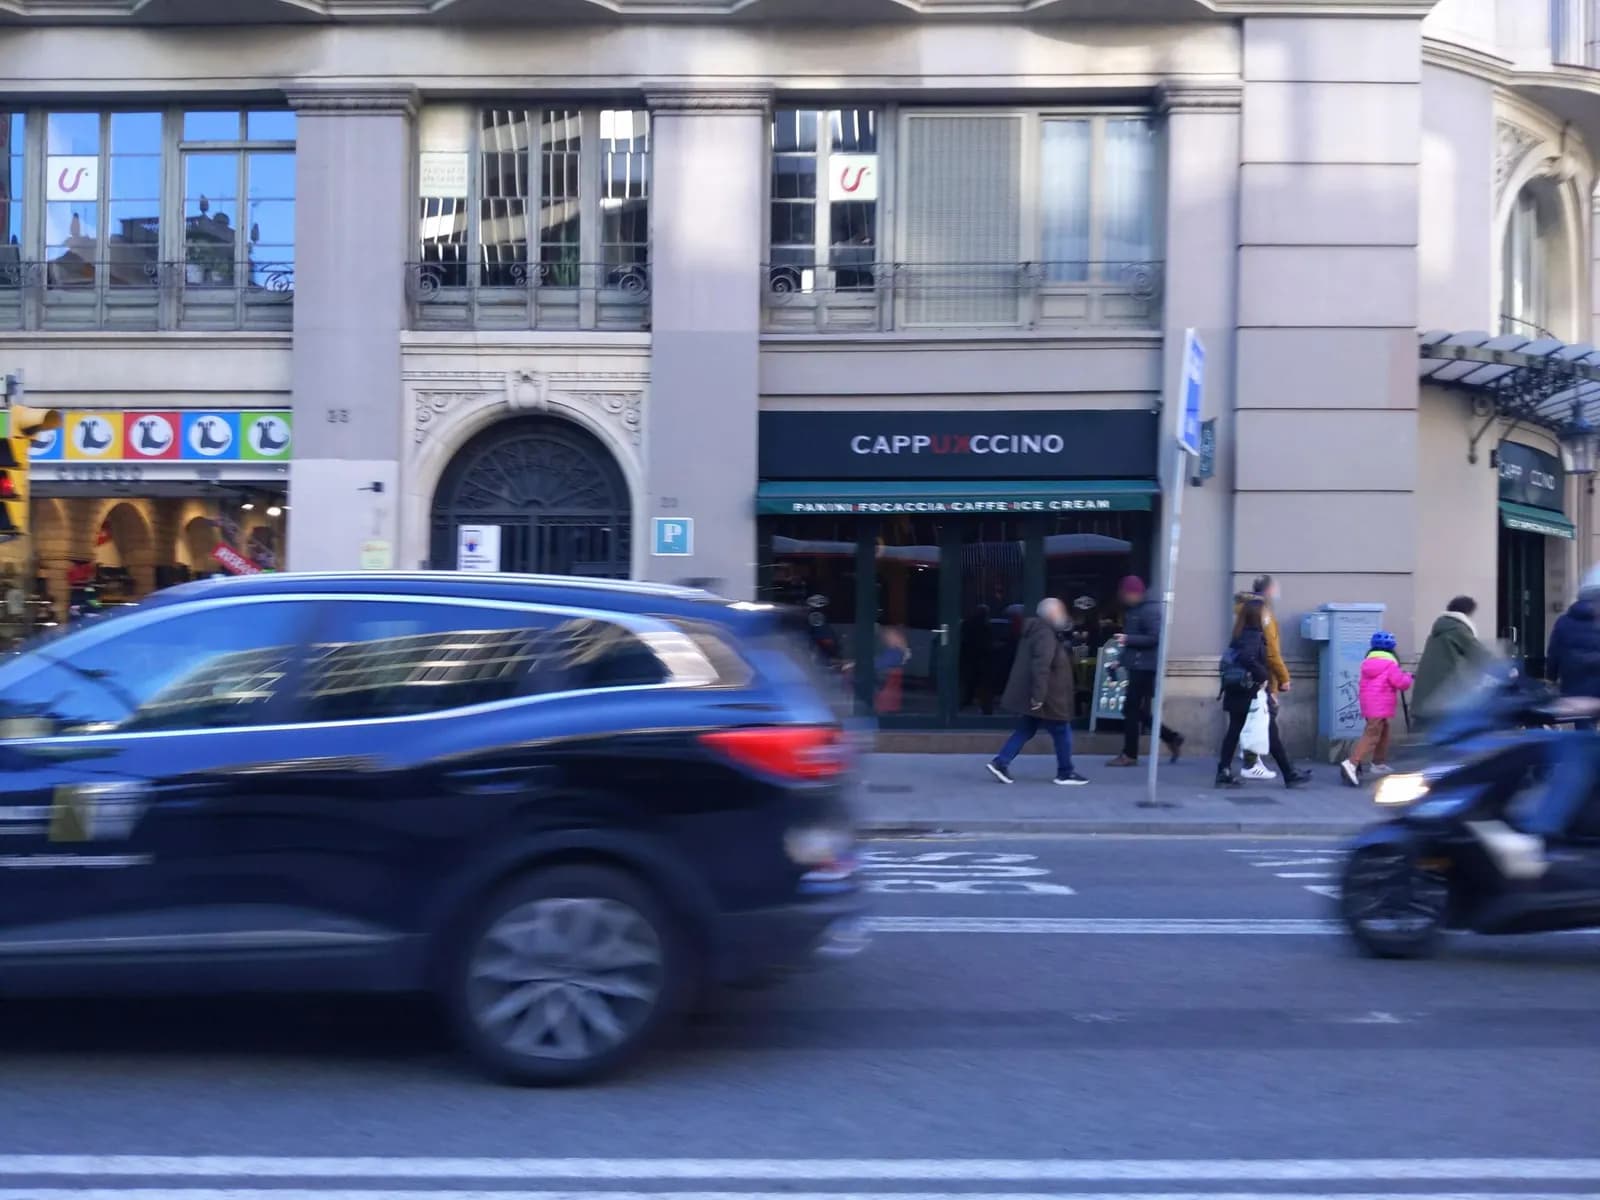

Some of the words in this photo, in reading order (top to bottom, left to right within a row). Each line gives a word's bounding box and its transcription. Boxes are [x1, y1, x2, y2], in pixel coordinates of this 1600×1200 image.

[850, 434, 1064, 454] CAPPUXCCINO
[791, 502, 853, 512] PANINI
[857, 502, 945, 511] FOCACCIA
[950, 501, 1008, 511] CAFFE
[1013, 501, 1045, 510] ICE
[1048, 499, 1110, 510] CREAM
[663, 523, 682, 543] P
